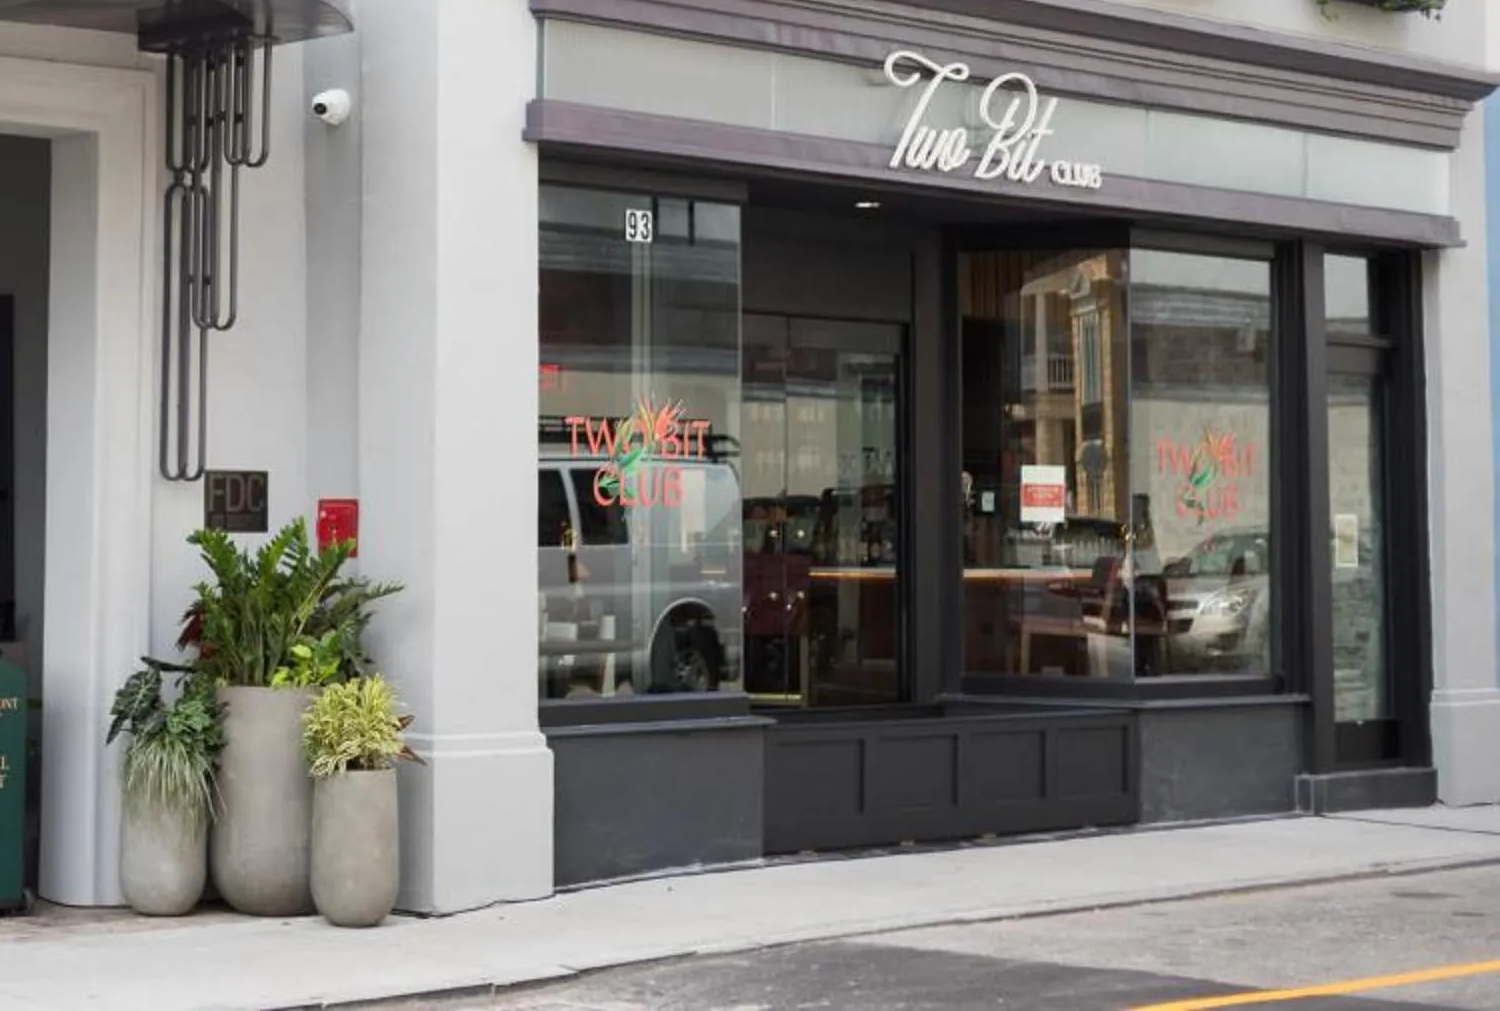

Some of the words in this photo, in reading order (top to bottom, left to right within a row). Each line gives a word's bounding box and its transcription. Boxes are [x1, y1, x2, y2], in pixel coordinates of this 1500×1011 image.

[884, 50, 970, 172] Two
[975, 72, 1058, 183] Bit
[1051, 159, 1102, 189] CLUB
[628, 212, 649, 240] 93
[208, 473, 264, 513] FDC
[593, 462, 683, 507] CLUB
